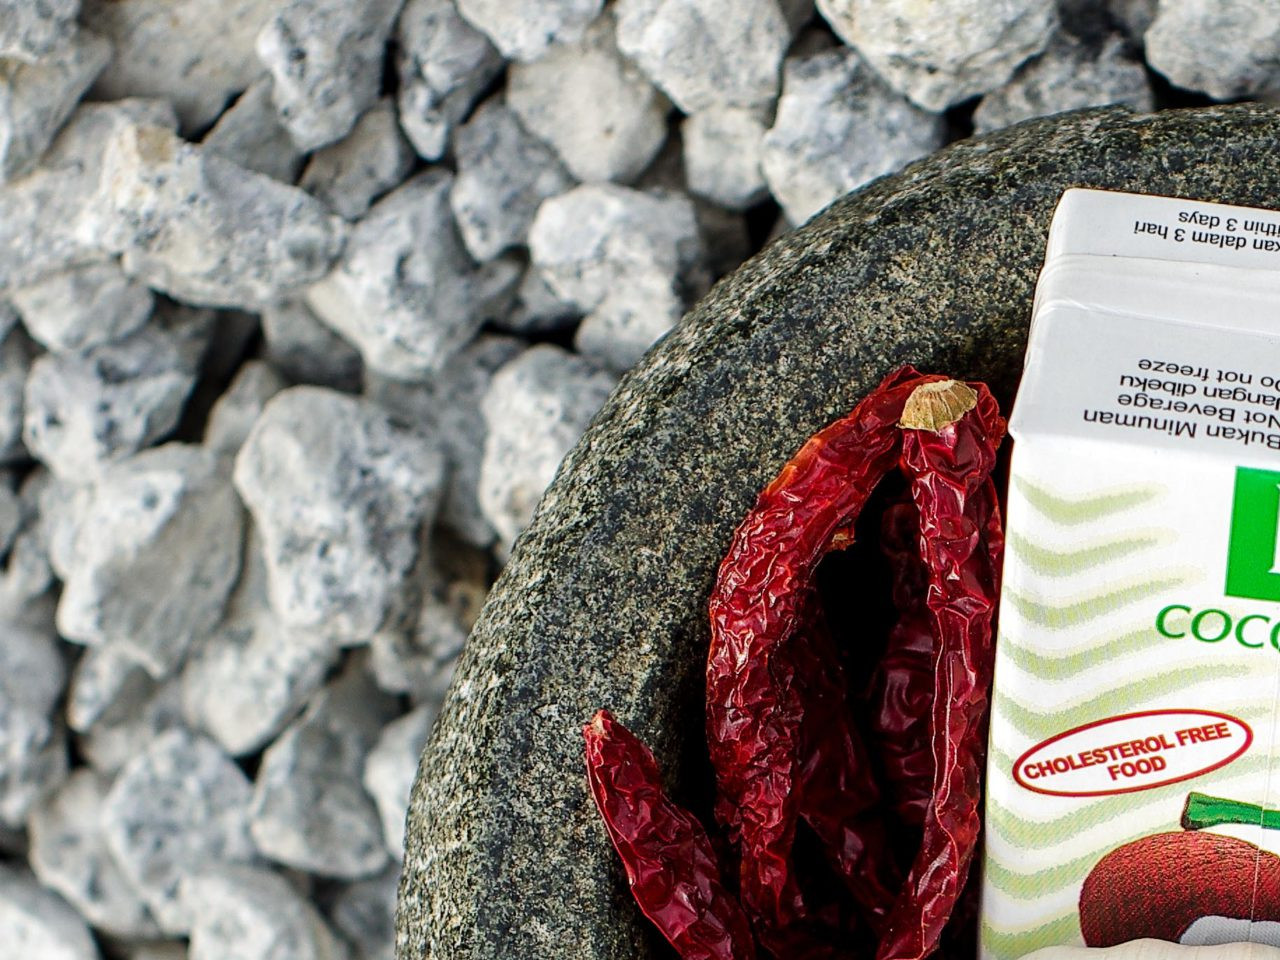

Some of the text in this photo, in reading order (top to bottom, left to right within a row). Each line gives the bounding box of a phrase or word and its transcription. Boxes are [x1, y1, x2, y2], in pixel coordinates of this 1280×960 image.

[1134, 220, 1168, 240] hari
[1179, 211, 1220, 228] days
[1226, 218, 1237, 232] 3
[1174, 228, 1186, 242] 3
[1191, 231, 1247, 250] dalam
[1138, 358, 1210, 381] freeze
[1217, 369, 1253, 385] not
[1120, 374, 1197, 397] dibeku
[1117, 393, 1236, 423] Beverage
[1083, 409, 1197, 438] Minuman
[1023, 722, 1232, 780] CHOLESTEROL FREE
[1107, 755, 1167, 781] FOOD
